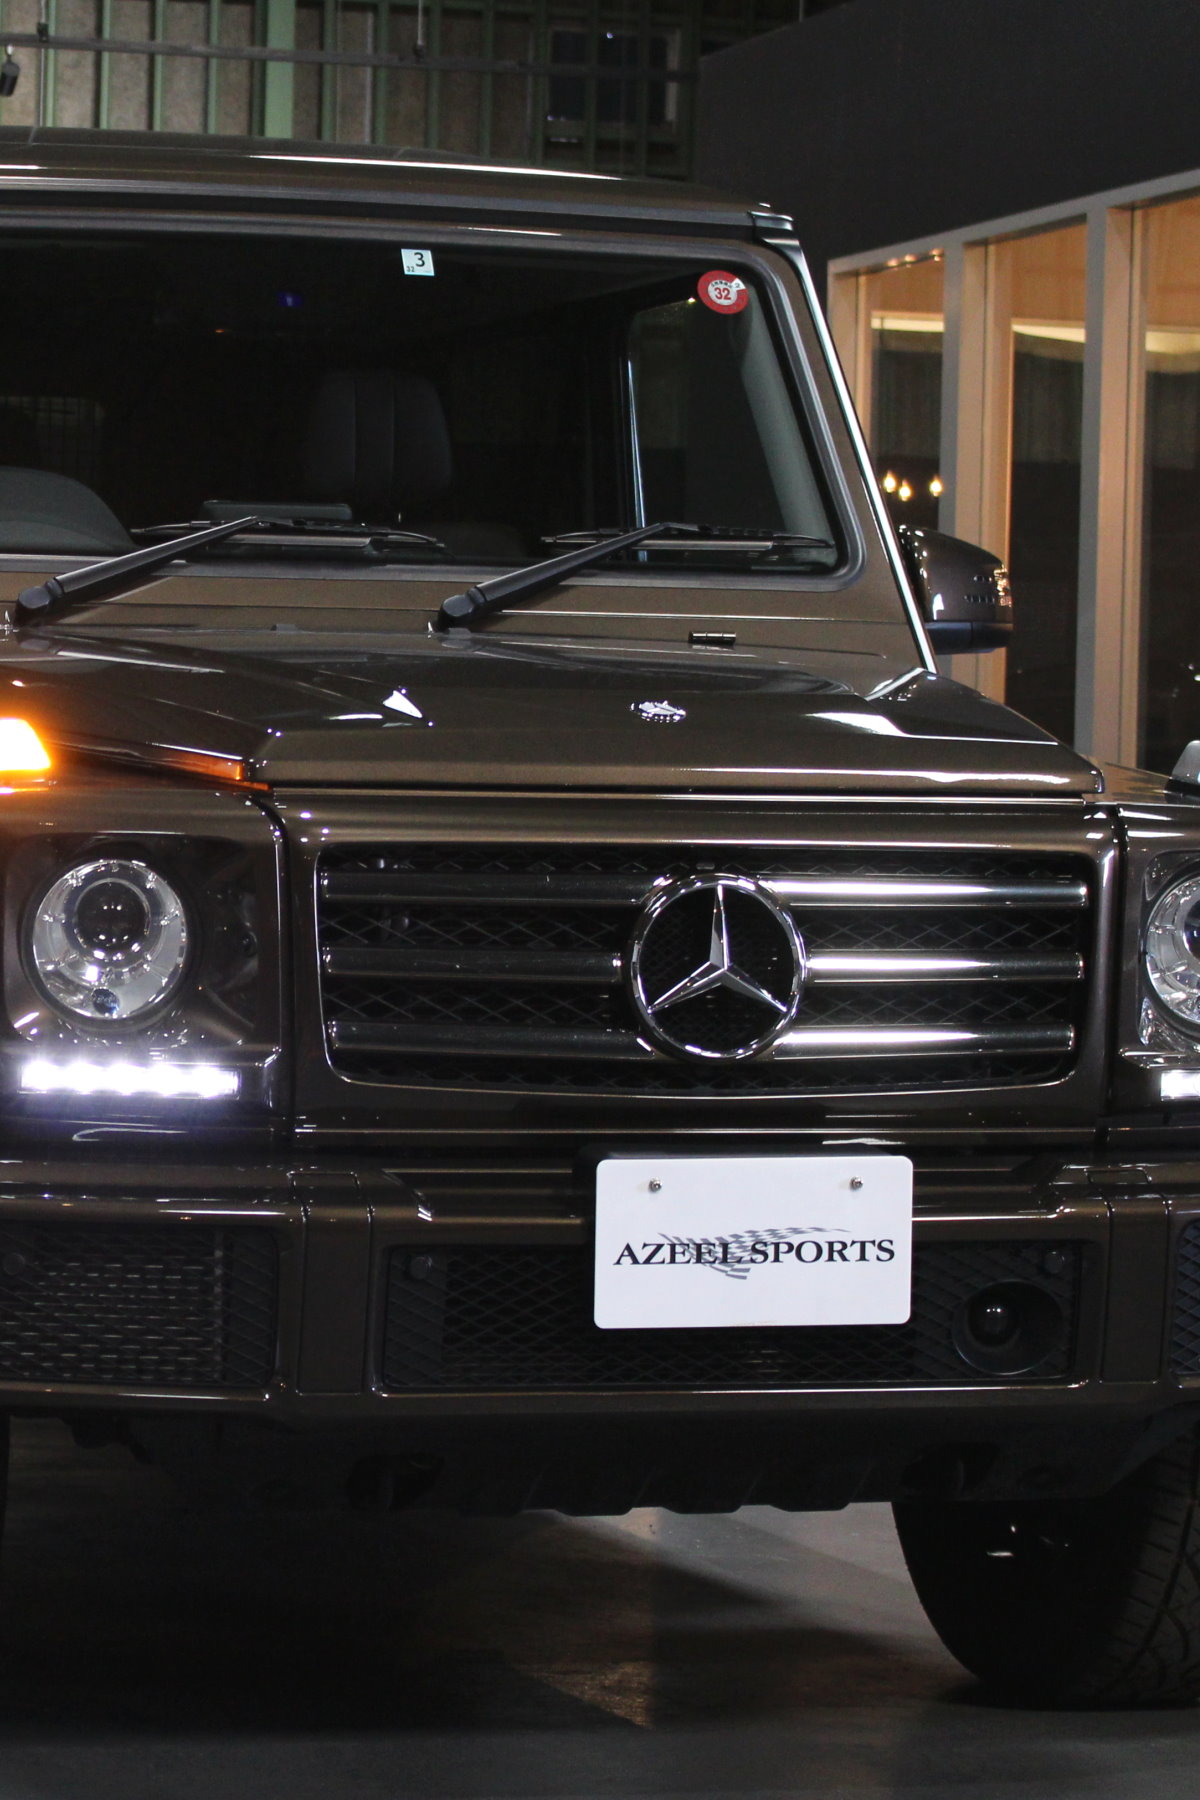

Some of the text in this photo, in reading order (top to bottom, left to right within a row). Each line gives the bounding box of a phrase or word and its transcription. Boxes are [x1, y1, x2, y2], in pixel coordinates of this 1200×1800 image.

[414, 252, 425, 267] 3
[714, 287, 732, 300] 32
[613, 1239, 895, 1266] AZEEL SPORTS
